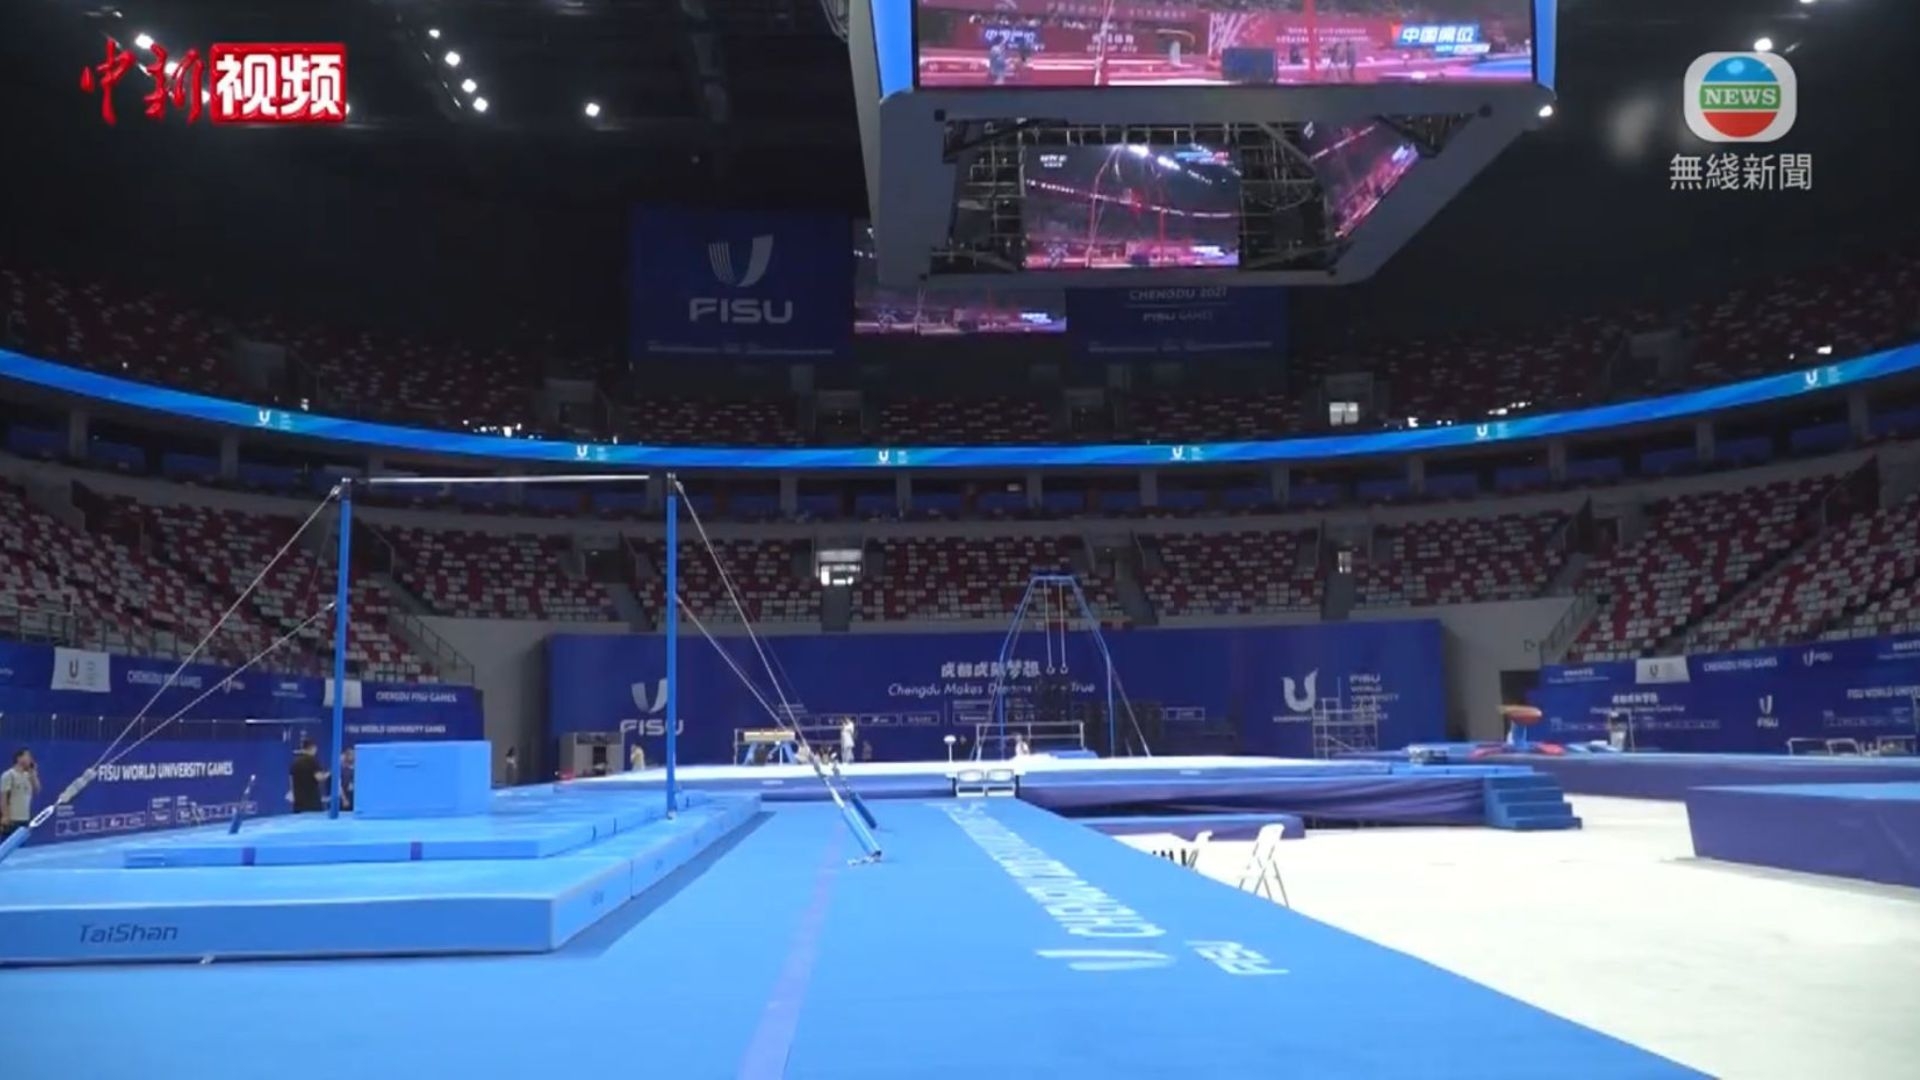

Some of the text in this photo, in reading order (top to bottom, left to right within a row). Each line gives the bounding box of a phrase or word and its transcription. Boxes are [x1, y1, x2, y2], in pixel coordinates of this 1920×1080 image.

[1129, 288, 1196, 301] CHENGDU
[689, 298, 793, 324] FISU
[888, 683, 940, 699] Chengdu
[944, 683, 983, 695] Makes
[1071, 682, 1096, 693] True
[98, 760, 233, 782] FISU WORLD UNIVERSITY GAMES
[80, 923, 179, 944] TaiShan
